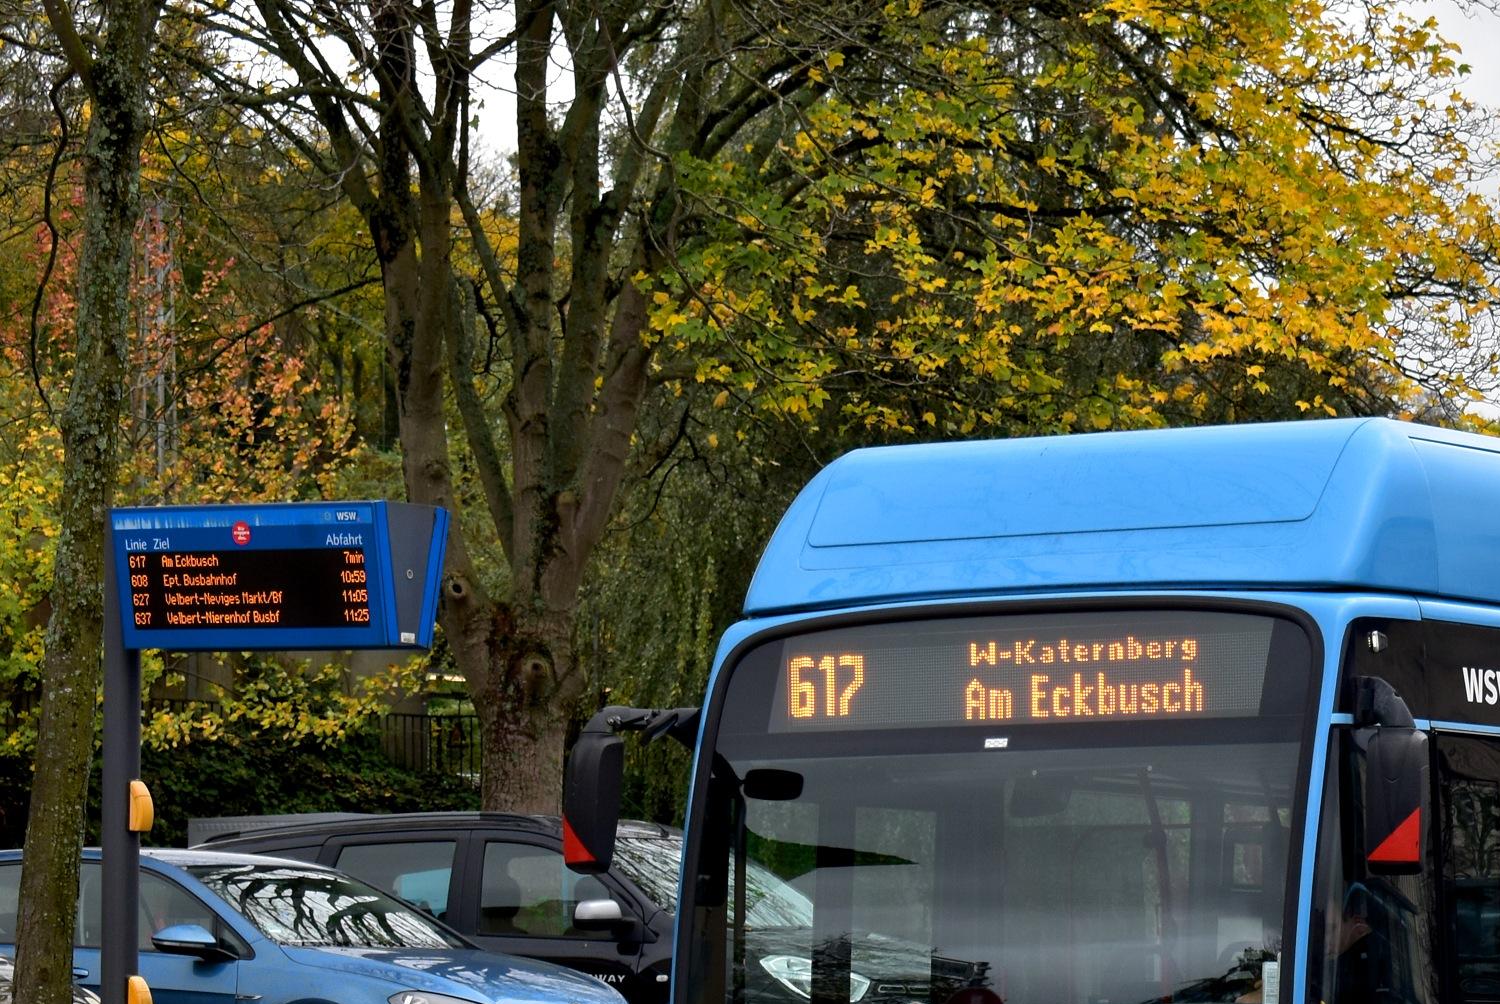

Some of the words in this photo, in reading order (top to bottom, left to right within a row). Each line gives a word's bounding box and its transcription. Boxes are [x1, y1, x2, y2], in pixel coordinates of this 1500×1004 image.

[336, 511, 357, 521] WSW
[125, 539, 147, 551] Linie
[153, 537, 170, 550] Ziel
[326, 533, 363, 546] Abfahrt
[129, 555, 146, 569] 617
[162, 555, 174, 568] Am
[175, 554, 219, 568] Eckbusch
[343, 551, 365, 564] 7min
[131, 575, 148, 588] 608
[183, 573, 238, 587] Busbahnhof
[341, 570, 366, 583] 10:59
[133, 593, 150, 606] 627
[165, 592, 241, 607] Velbert-Neviges
[342, 589, 368, 602] 11:05
[134, 612, 151, 625] 637
[167, 611, 250, 625] Velbert-Nierenhof
[253, 610, 280, 624] Busbf
[344, 608, 370, 622] 11:25
[969, 636, 1198, 666] W-Katernberg
[788, 654, 865, 719] 617
[965, 677, 1013, 721] Am
[1030, 668, 1204, 718] Eckbusch
